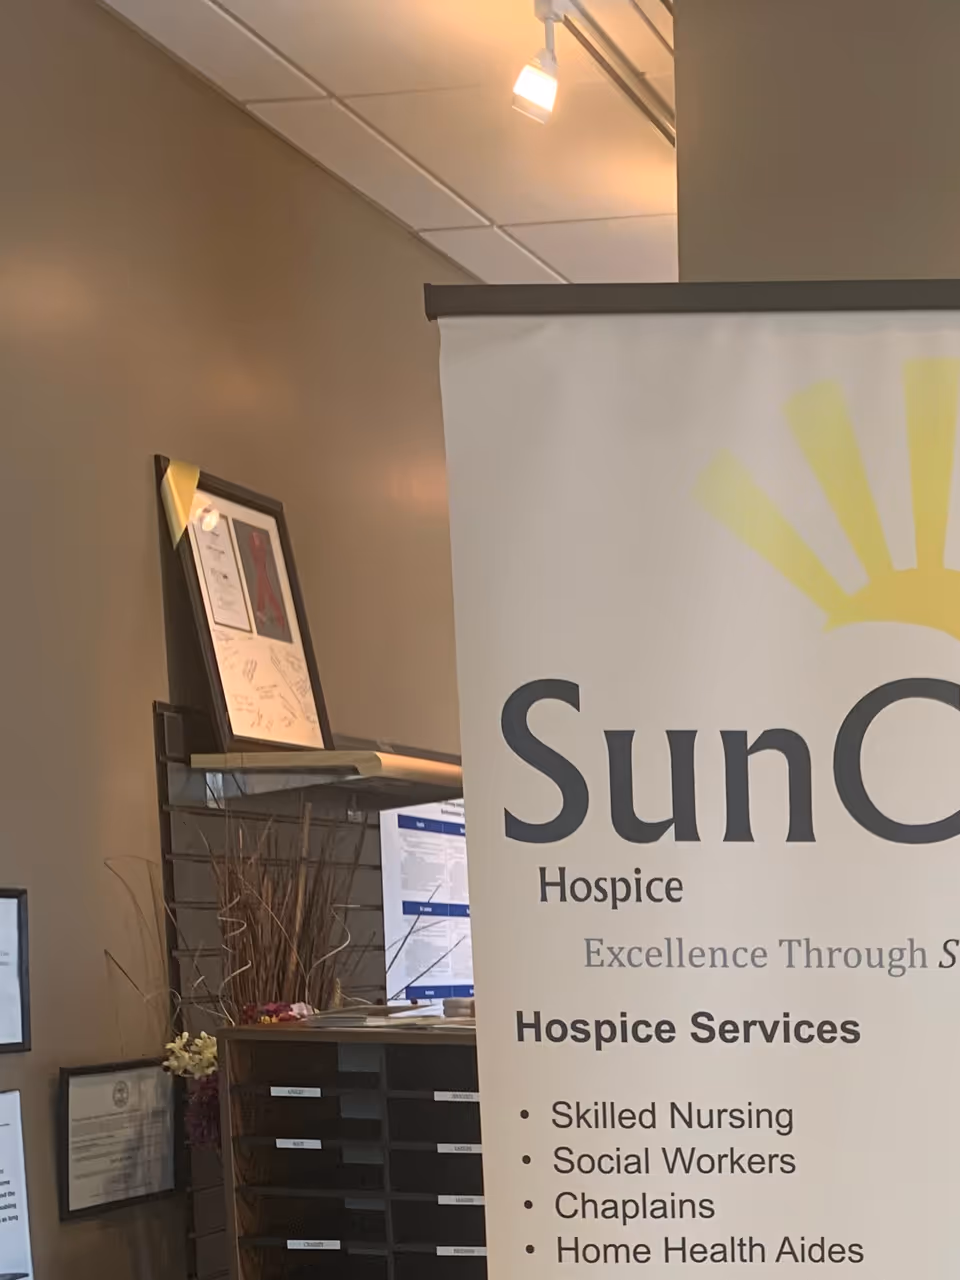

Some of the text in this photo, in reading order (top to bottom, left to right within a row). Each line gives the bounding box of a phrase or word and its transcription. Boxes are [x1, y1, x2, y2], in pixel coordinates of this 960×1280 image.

[539, 867, 683, 909] Hospice
[584, 938, 767, 968] Excellence
[779, 938, 927, 977] Through
[517, 1011, 860, 1051] Hospice Services
[552, 1101, 792, 1136] Skilled Nursing
[554, 1147, 795, 1174] Social Workers
[556, 1192, 714, 1225] Chaplains
[558, 1237, 863, 1263] Home Health Aides
